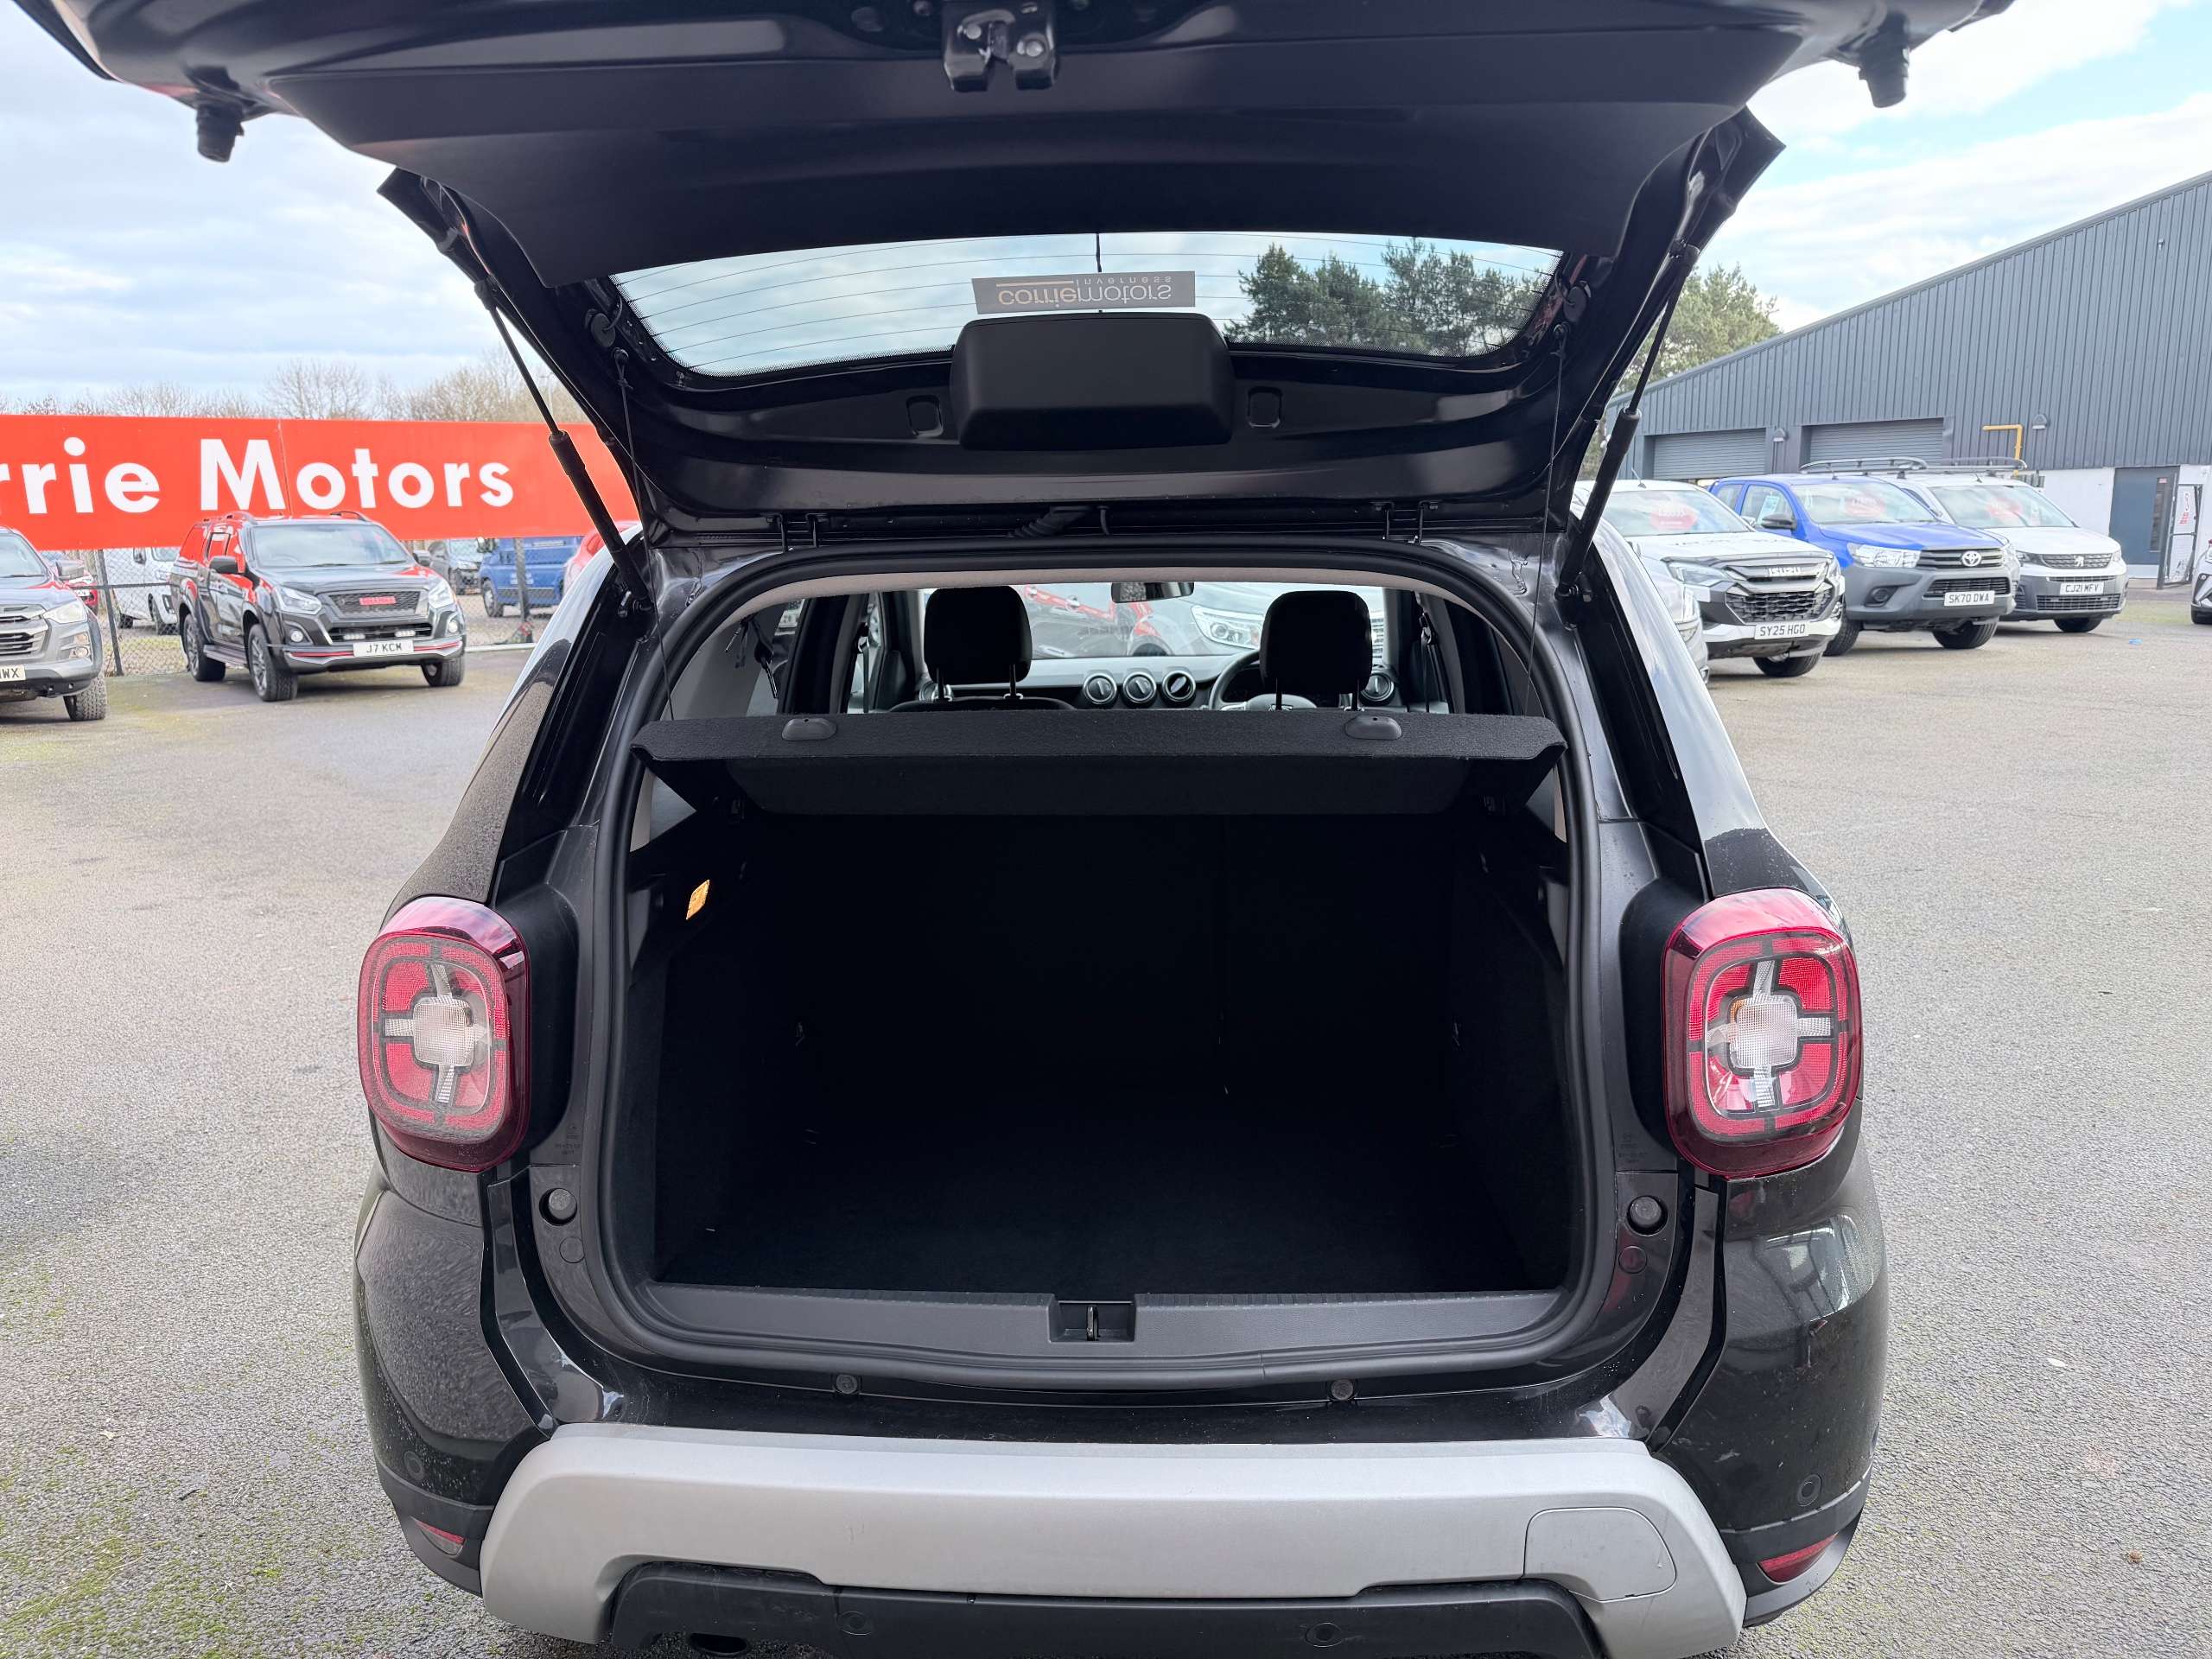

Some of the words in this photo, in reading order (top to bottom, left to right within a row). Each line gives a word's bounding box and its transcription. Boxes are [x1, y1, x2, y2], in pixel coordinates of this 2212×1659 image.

[0, 437, 161, 514] rie
[200, 438, 514, 511] Motors
[1948, 594, 1972, 604] SK70
[1974, 593, 1990, 602] DWA
[1759, 625, 1785, 637] SY25
[0, 667, 19, 679] WX
